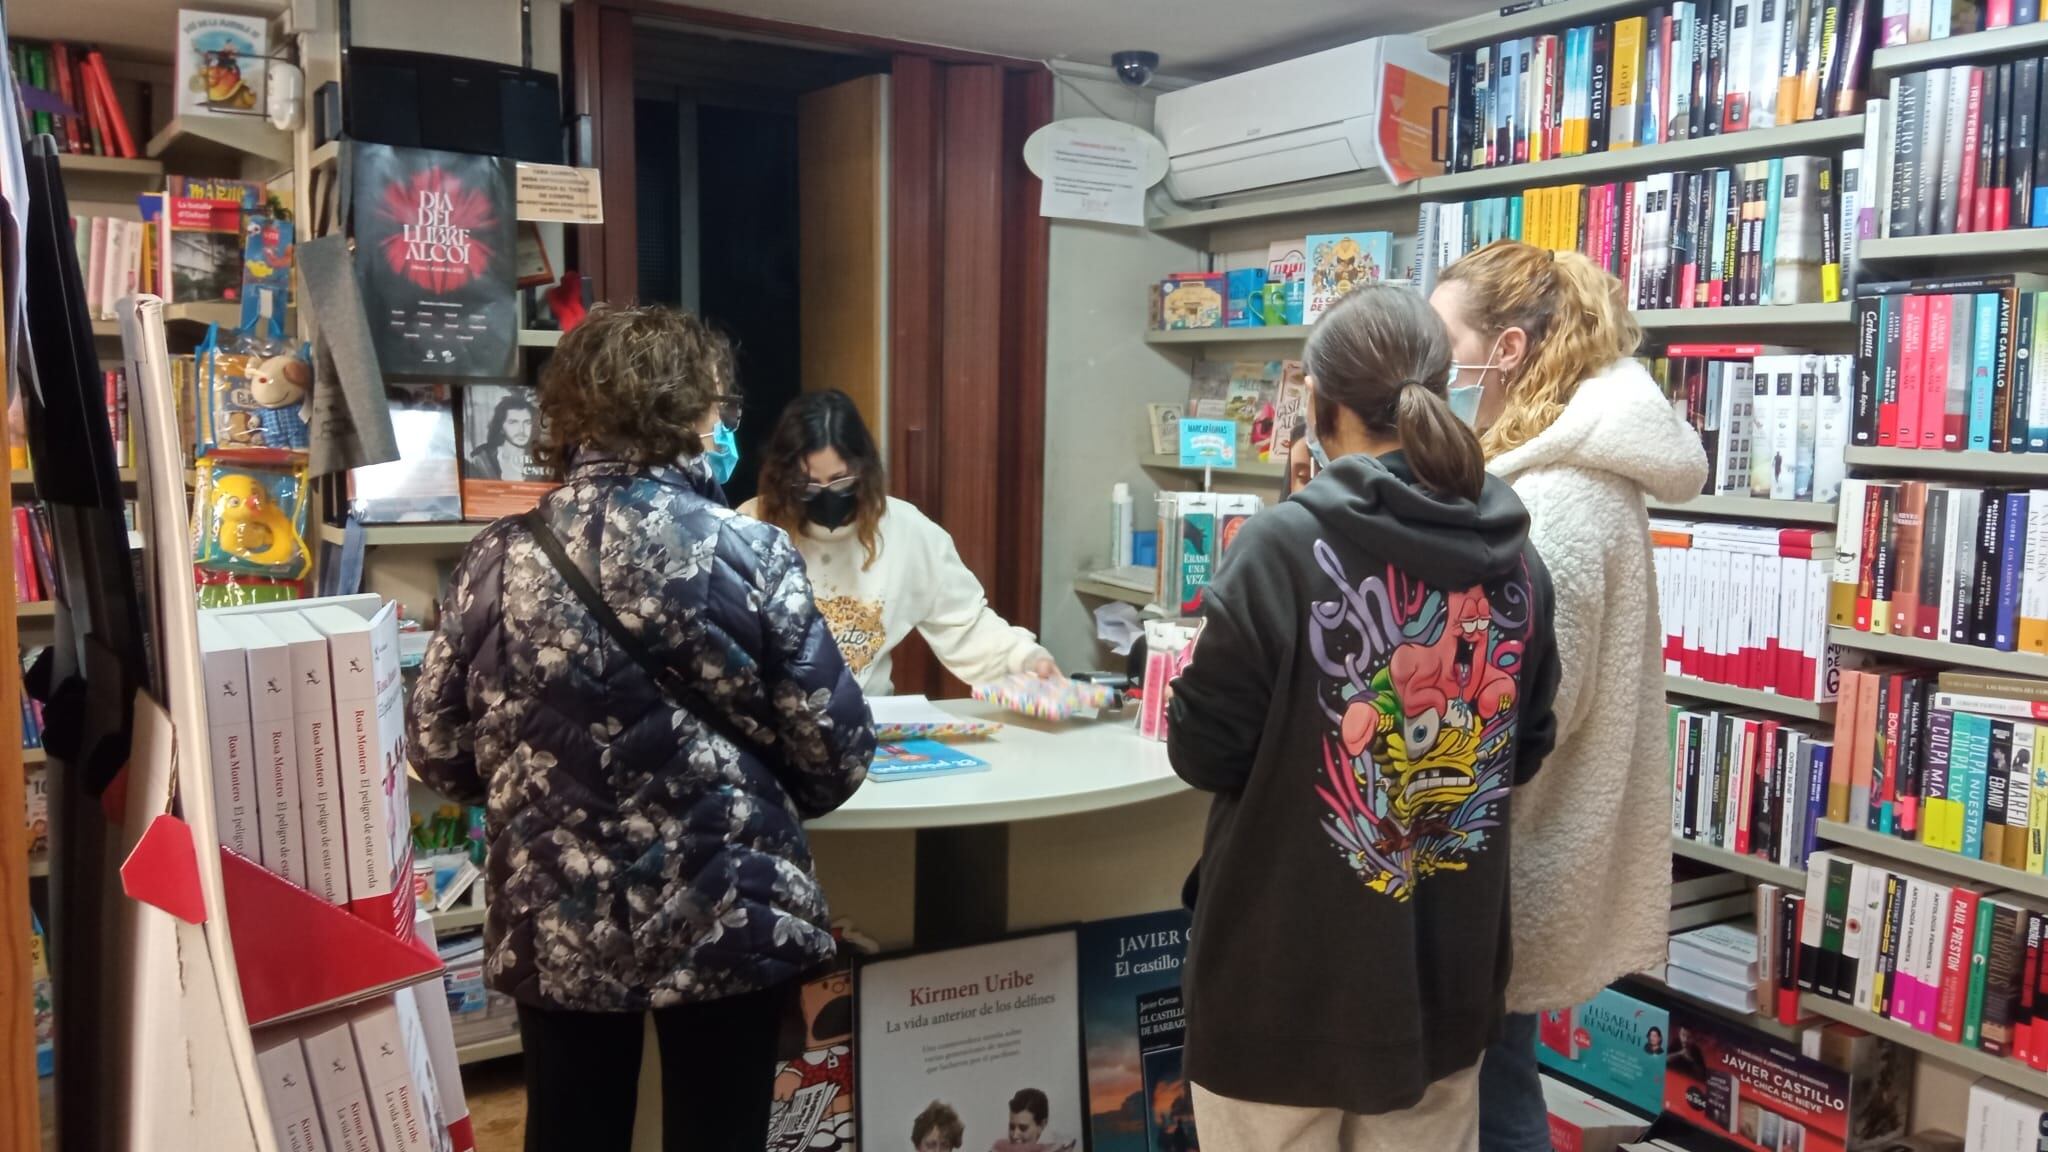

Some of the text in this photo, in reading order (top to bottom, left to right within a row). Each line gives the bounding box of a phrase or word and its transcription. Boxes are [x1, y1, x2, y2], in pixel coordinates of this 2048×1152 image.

[1591, 65, 1603, 120] anhelo
[1617, 63, 1629, 106] ulgor
[1901, 85, 1917, 154] ARTURO
[418, 207, 450, 226] DEL
[403, 224, 471, 246] LLIBRE
[1410, 259, 1422, 286] PEDRO
[1864, 311, 1877, 358] Cerbantes
[1996, 297, 2011, 388] JAVIER CASTILLO
[1984, 505, 1993, 547] INDESEABLE
[1989, 499, 2000, 554] POLÍTICAMENTE
[1956, 589, 1966, 625] GUERRERA
[312, 722, 322, 746] Rosa
[355, 710, 365, 732] Rosa
[1887, 712, 1898, 746] BOWIE
[272, 731, 282, 754] Rosa
[357, 733, 367, 775] Montero
[274, 756, 284, 798] Montero
[314, 747, 325, 787] Montero
[1929, 726, 1950, 797] CULPA MÍA
[1951, 731, 1971, 803] CULPA TUY
[228, 735, 246, 852] Rosa Montero El peligro
[277, 801, 287, 809] El
[359, 788, 371, 819] peligro
[1965, 735, 1988, 843] CULPA NUESTRA
[1987, 776, 2006, 808] ÉBANO
[276, 813, 288, 845] peligro
[317, 802, 329, 835] peligro
[364, 821, 372, 830] de
[281, 846, 289, 857] de
[322, 836, 330, 845] de
[322, 847, 331, 866] estar
[365, 831, 374, 856] estar
[324, 868, 334, 898] cuerd
[367, 859, 376, 889] cuerda
[1904, 886, 1918, 963] ANTOLOGÍA FEMINISTA
[1925, 893, 1939, 969] ANTOLOGÍA FEMINISTA
[1947, 900, 1967, 972] PAUL PRESTON
[2027, 917, 2041, 948] GONZÁLEZ
[1117, 929, 1181, 958] JAVIER
[1115, 954, 1180, 978] El castillo
[910, 970, 1034, 1007] Kirmen Uribe
[886, 993, 1056, 1034] La vida anterior de los delfines
[1154, 1018, 1186, 1033] BARBAZ
[1722, 1053, 1769, 1080] JAVIER
[1774, 1075, 1844, 1111] CASTILLO
[1740, 1074, 1823, 1113] LA CHICA DE NIEVE
[351, 1102, 363, 1136] Kirmen
[388, 1103, 399, 1122] vida
[399, 1085, 419, 1143] Kirmen Uribe
